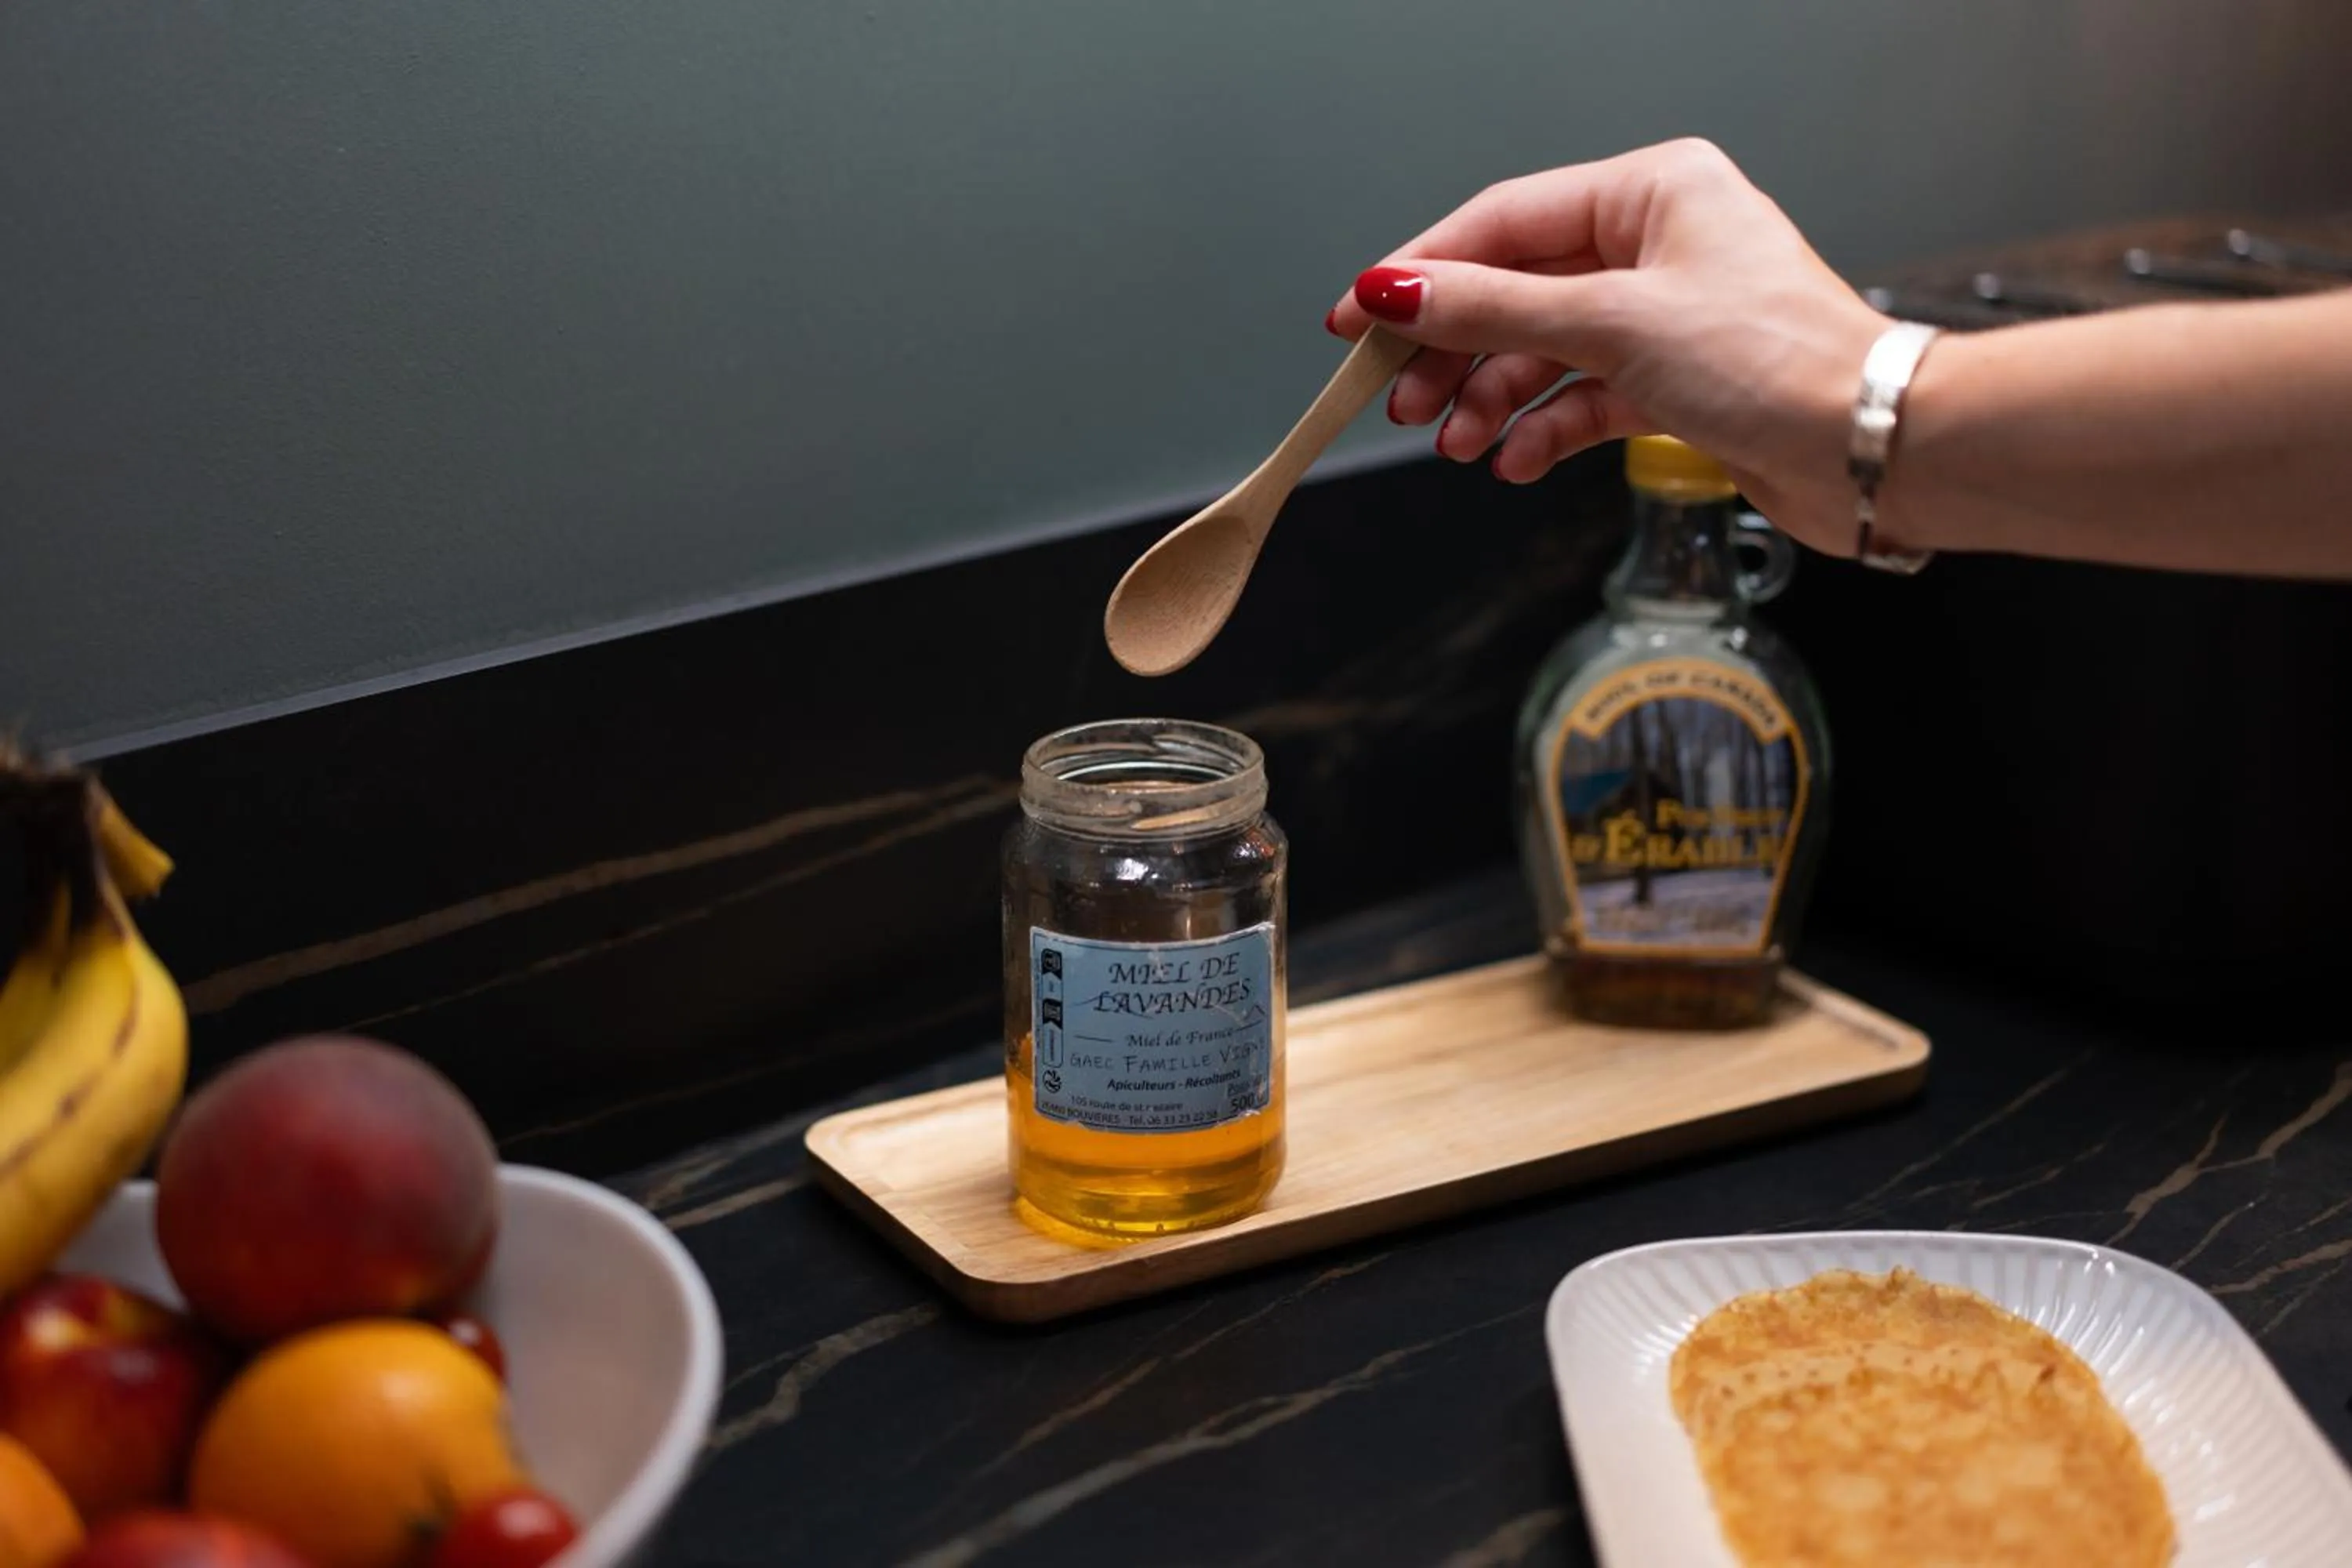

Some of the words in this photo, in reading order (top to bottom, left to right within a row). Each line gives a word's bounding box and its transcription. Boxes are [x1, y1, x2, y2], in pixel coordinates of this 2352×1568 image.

[1108, 961, 1191, 985] MIEL
[1200, 952, 1241, 980] DE
[1093, 977, 1252, 1014] LAVANDES
[1126, 1033, 1164, 1047] Miel
[1165, 1030, 1181, 1047] de
[1070, 1052, 1114, 1069] GAEC
[1122, 1054, 1211, 1074] FAMILLE
[1106, 1079, 1177, 1092] Apiculteurs
